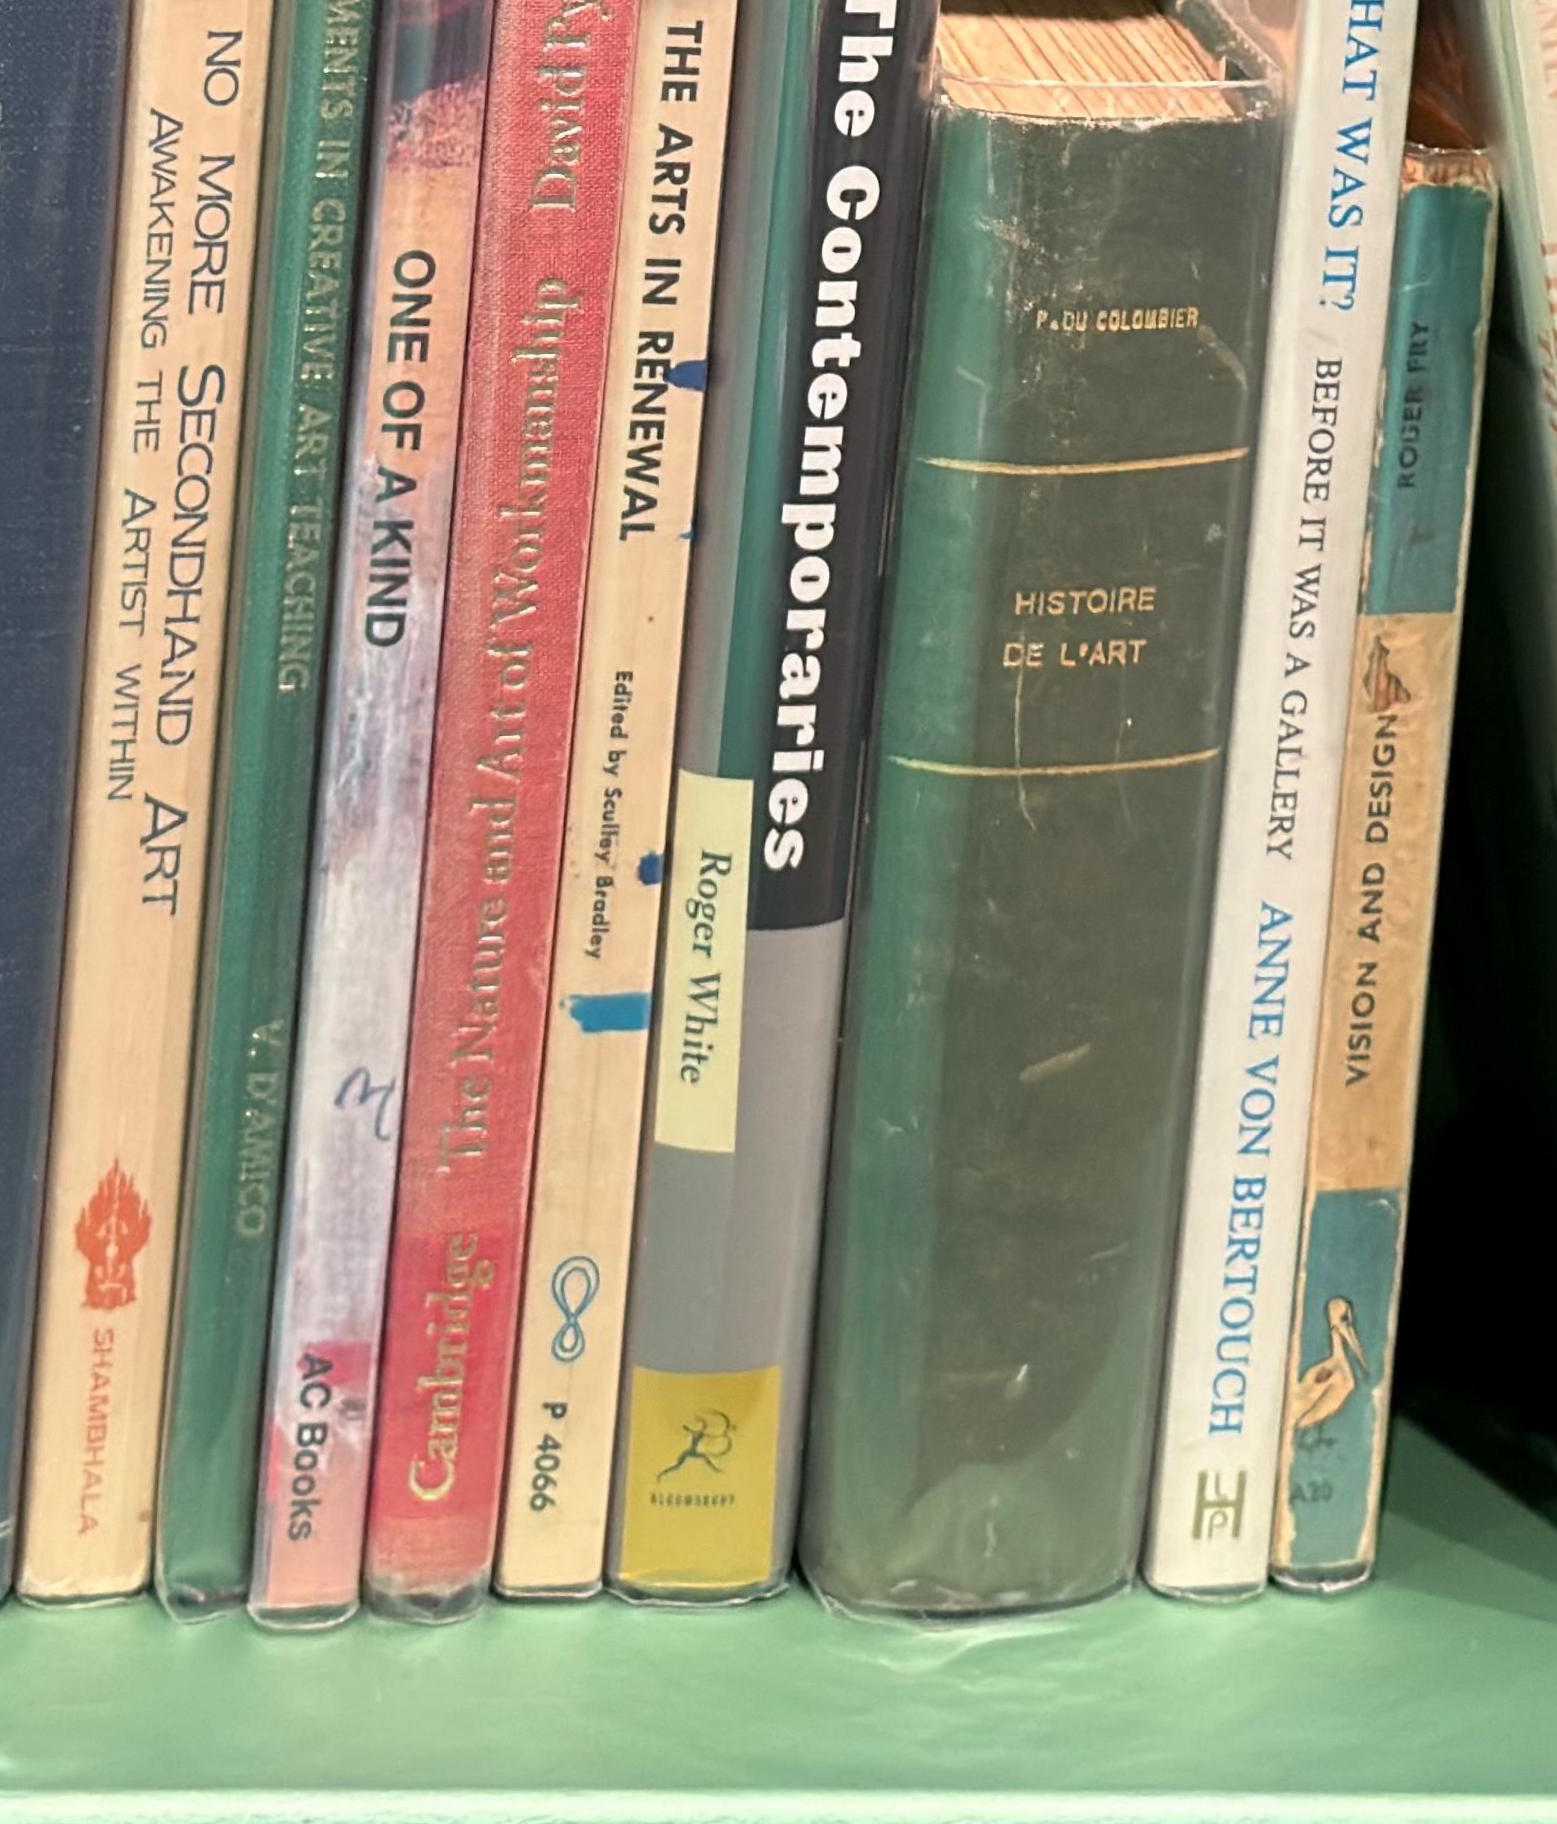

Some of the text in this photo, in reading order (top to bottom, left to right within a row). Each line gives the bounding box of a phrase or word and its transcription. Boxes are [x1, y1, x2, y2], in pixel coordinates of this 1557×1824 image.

[619, 20, 702, 541] THE ARTS IN RENEWAL
[1319, 243, 1361, 313] IT?
[1328, 116, 1372, 229] WAS
[365, 250, 436, 648] ONE OF A KIND
[1097, 306, 1198, 331] COLOMBIER
[108, 108, 184, 801] AWAKENING THE ARTIST WITHIN
[140, 30, 242, 916] NO MORE SECONDHAND ART
[765, 165, 880, 870] Contemporaries
[1004, 638, 1146, 667] DE L'ART
[1015, 587, 1155, 617] HISTOIRE
[585, 671, 633, 959] Edited by Sculley Bradley
[1346, 715, 1398, 1086] VISION AND DESIGN
[679, 851, 732, 1085] Roger White
[1209, 902, 1293, 1436] ANNE VON BERTOUCH
[288, 1353, 332, 1542] AC Books
[530, 1402, 567, 1512] P 4066
